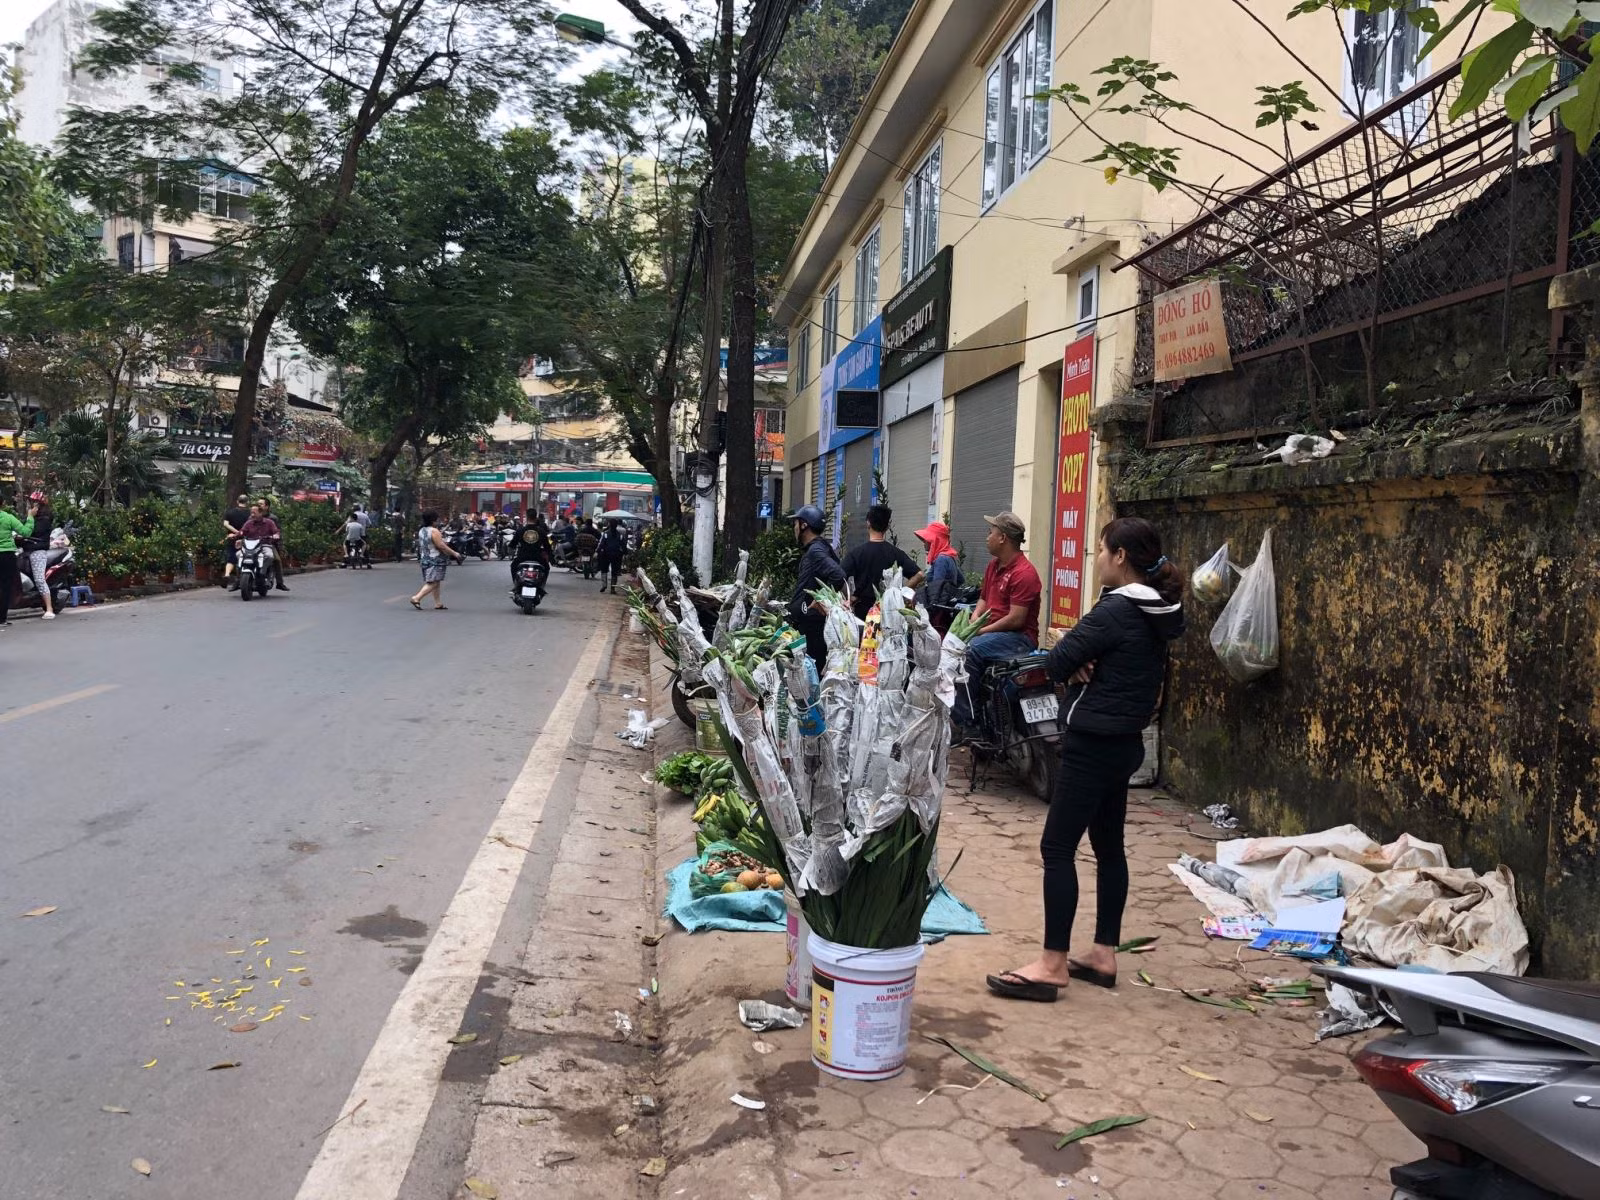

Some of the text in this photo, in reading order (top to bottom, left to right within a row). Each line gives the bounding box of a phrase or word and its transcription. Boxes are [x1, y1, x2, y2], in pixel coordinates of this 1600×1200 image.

[1164, 342, 1215, 368] 0964882469
[1066, 360, 1078, 379] Minh
[1062, 391, 1090, 436] PHOTO
[223, 445, 231, 455] 2
[1061, 451, 1085, 494] COPY
[1062, 506, 1079, 529] MÁY
[1062, 536, 1076, 559] VĂN
[1055, 565, 1079, 589] PHÒNG
[1026, 696, 1053, 711] 89-E1
